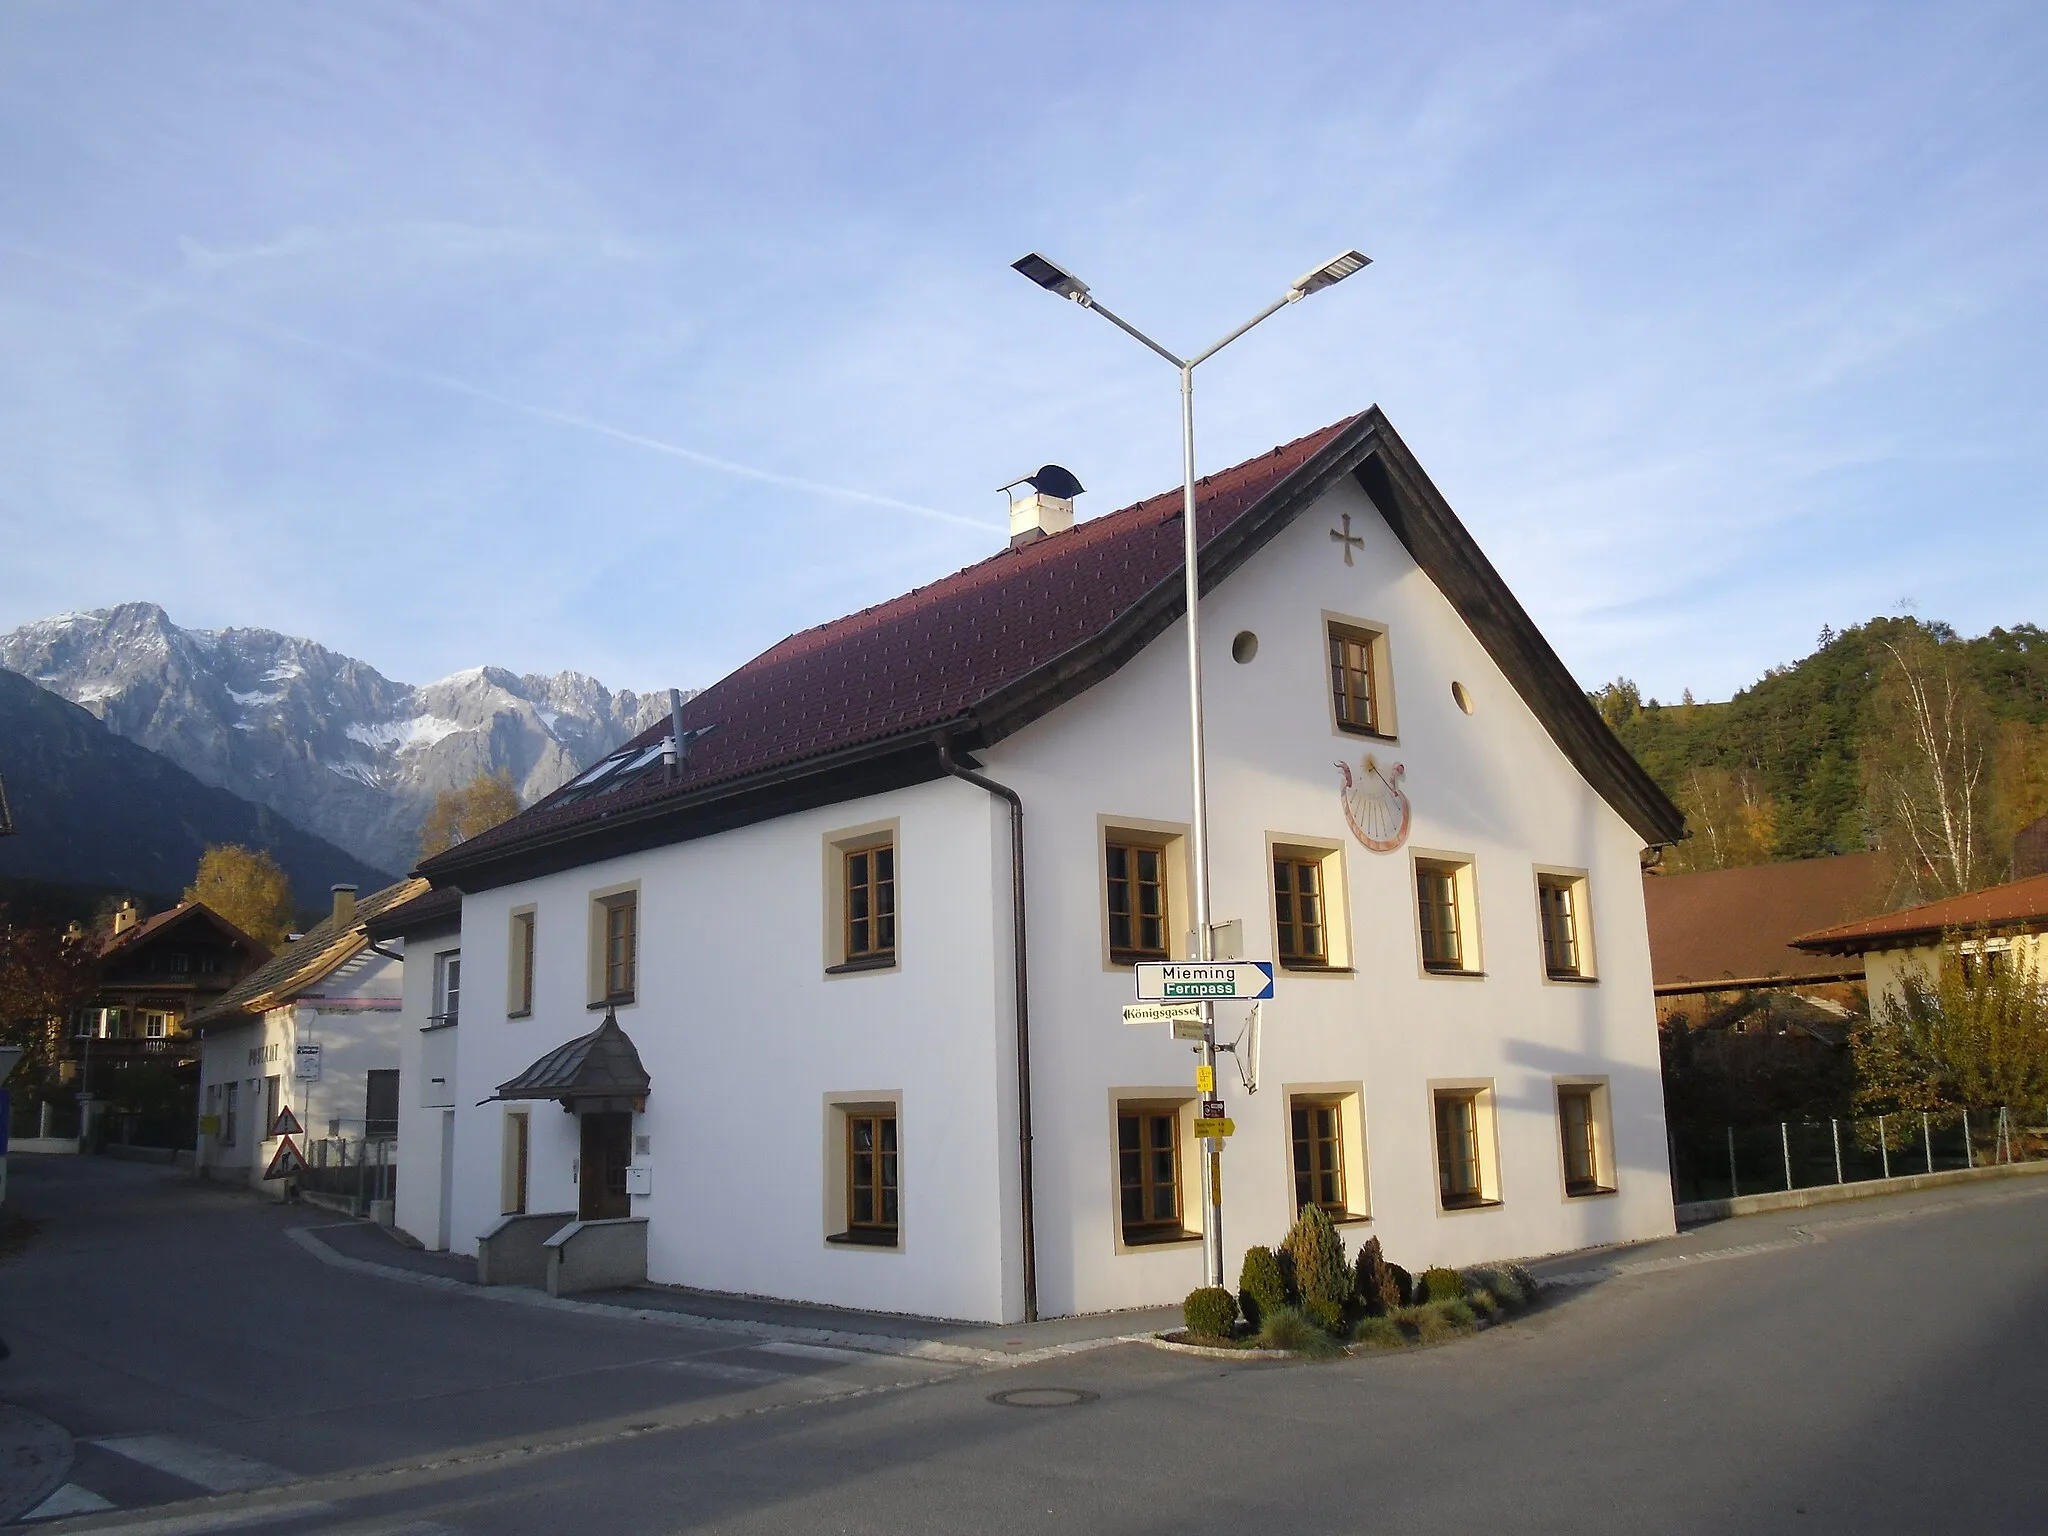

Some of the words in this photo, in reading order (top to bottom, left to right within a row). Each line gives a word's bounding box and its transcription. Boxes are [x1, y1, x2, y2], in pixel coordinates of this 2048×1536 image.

[1163, 967, 1235, 982] Mieming
[1166, 983, 1233, 996] Fernpass
[1127, 1006, 1196, 1019] Königsgasse
